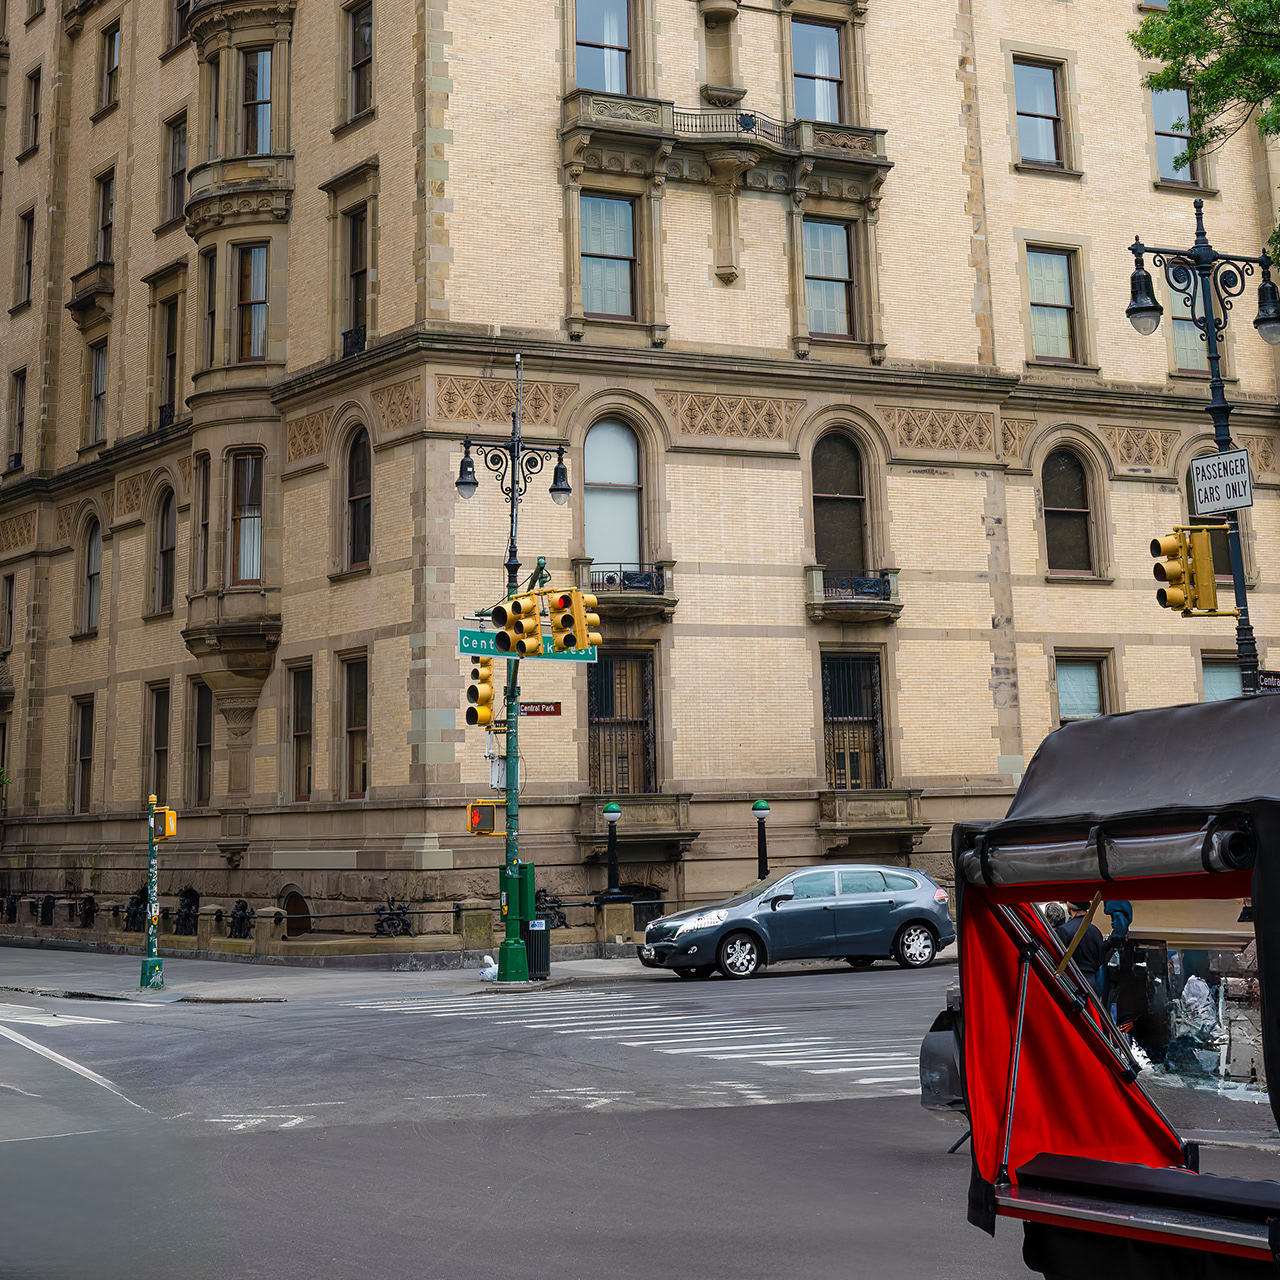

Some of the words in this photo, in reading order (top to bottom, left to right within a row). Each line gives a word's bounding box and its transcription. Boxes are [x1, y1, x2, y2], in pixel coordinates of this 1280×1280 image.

[1195, 458, 1246, 482] PASSENGER
[1198, 485, 1221, 504] CARS
[1225, 480, 1247, 500] ONLY
[521, 704, 540, 712] Central
[541, 704, 555, 712] Park
